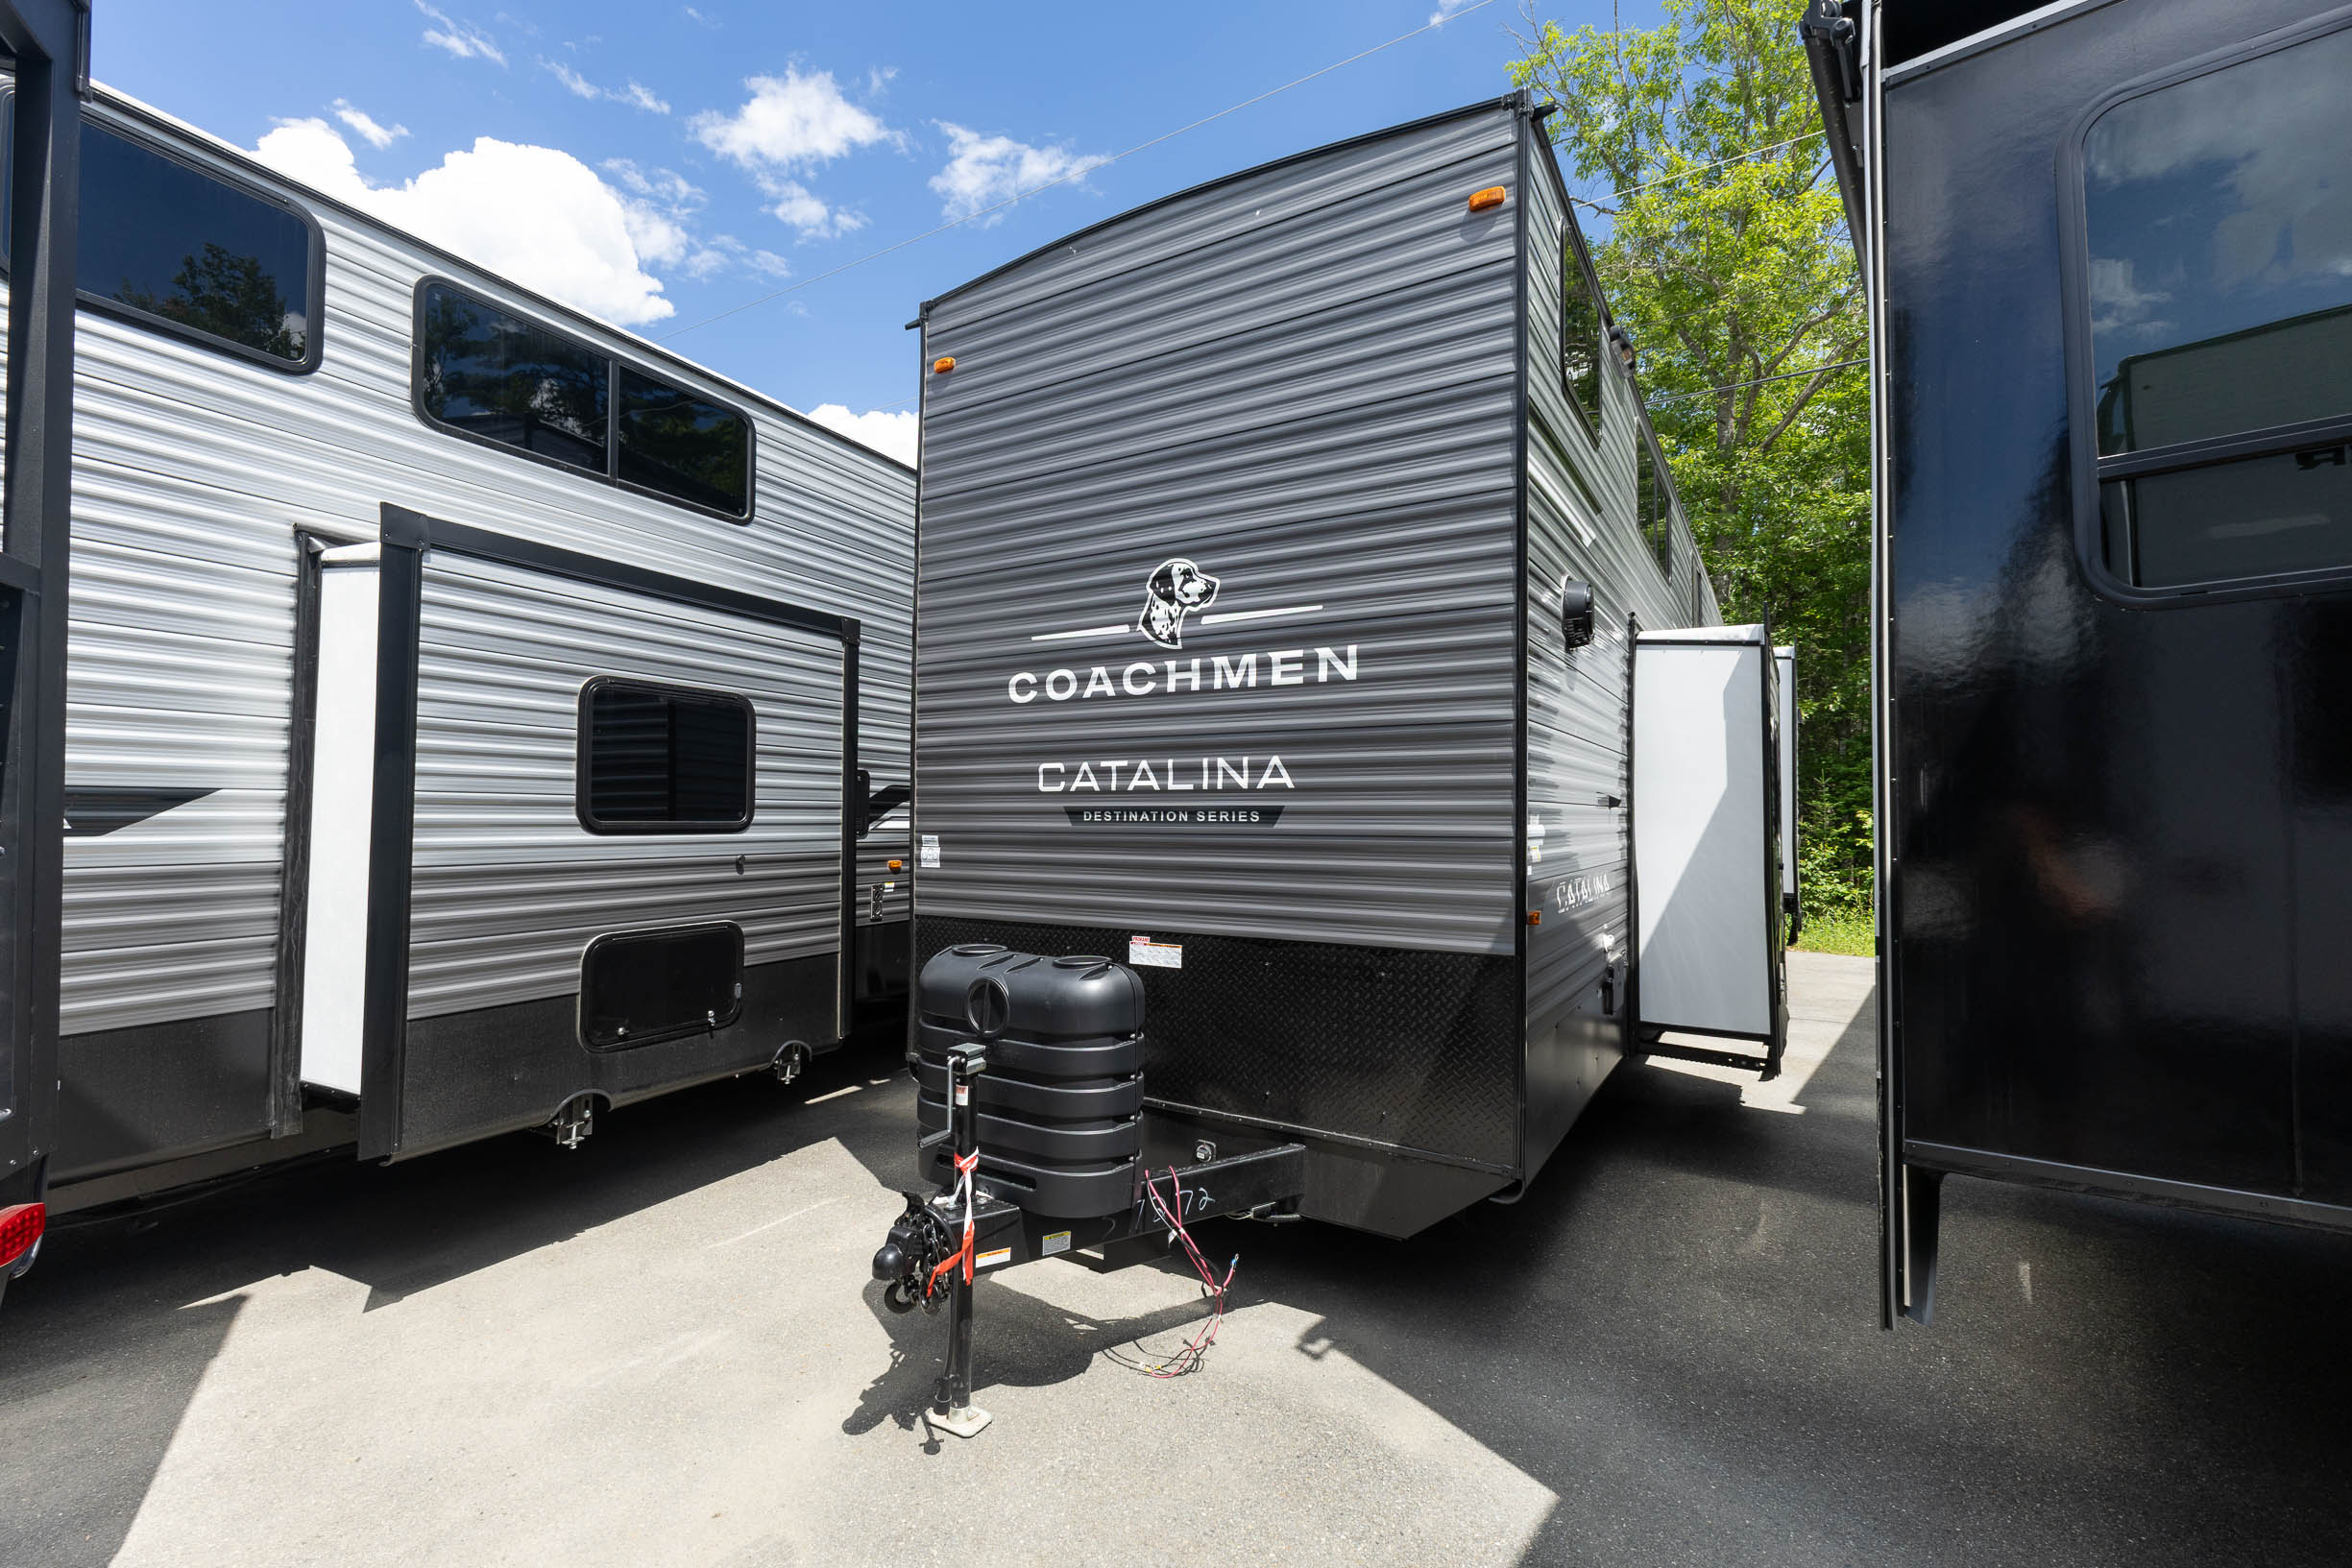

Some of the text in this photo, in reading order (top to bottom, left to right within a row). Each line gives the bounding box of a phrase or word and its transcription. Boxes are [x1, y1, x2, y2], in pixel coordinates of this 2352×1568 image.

[1007, 644, 1358, 704] COACHMEN
[1037, 755, 1296, 793] CATALINA
[1083, 810, 1260, 823] DESTINATION SERIES
[1556, 874, 1611, 914] CATALINA
